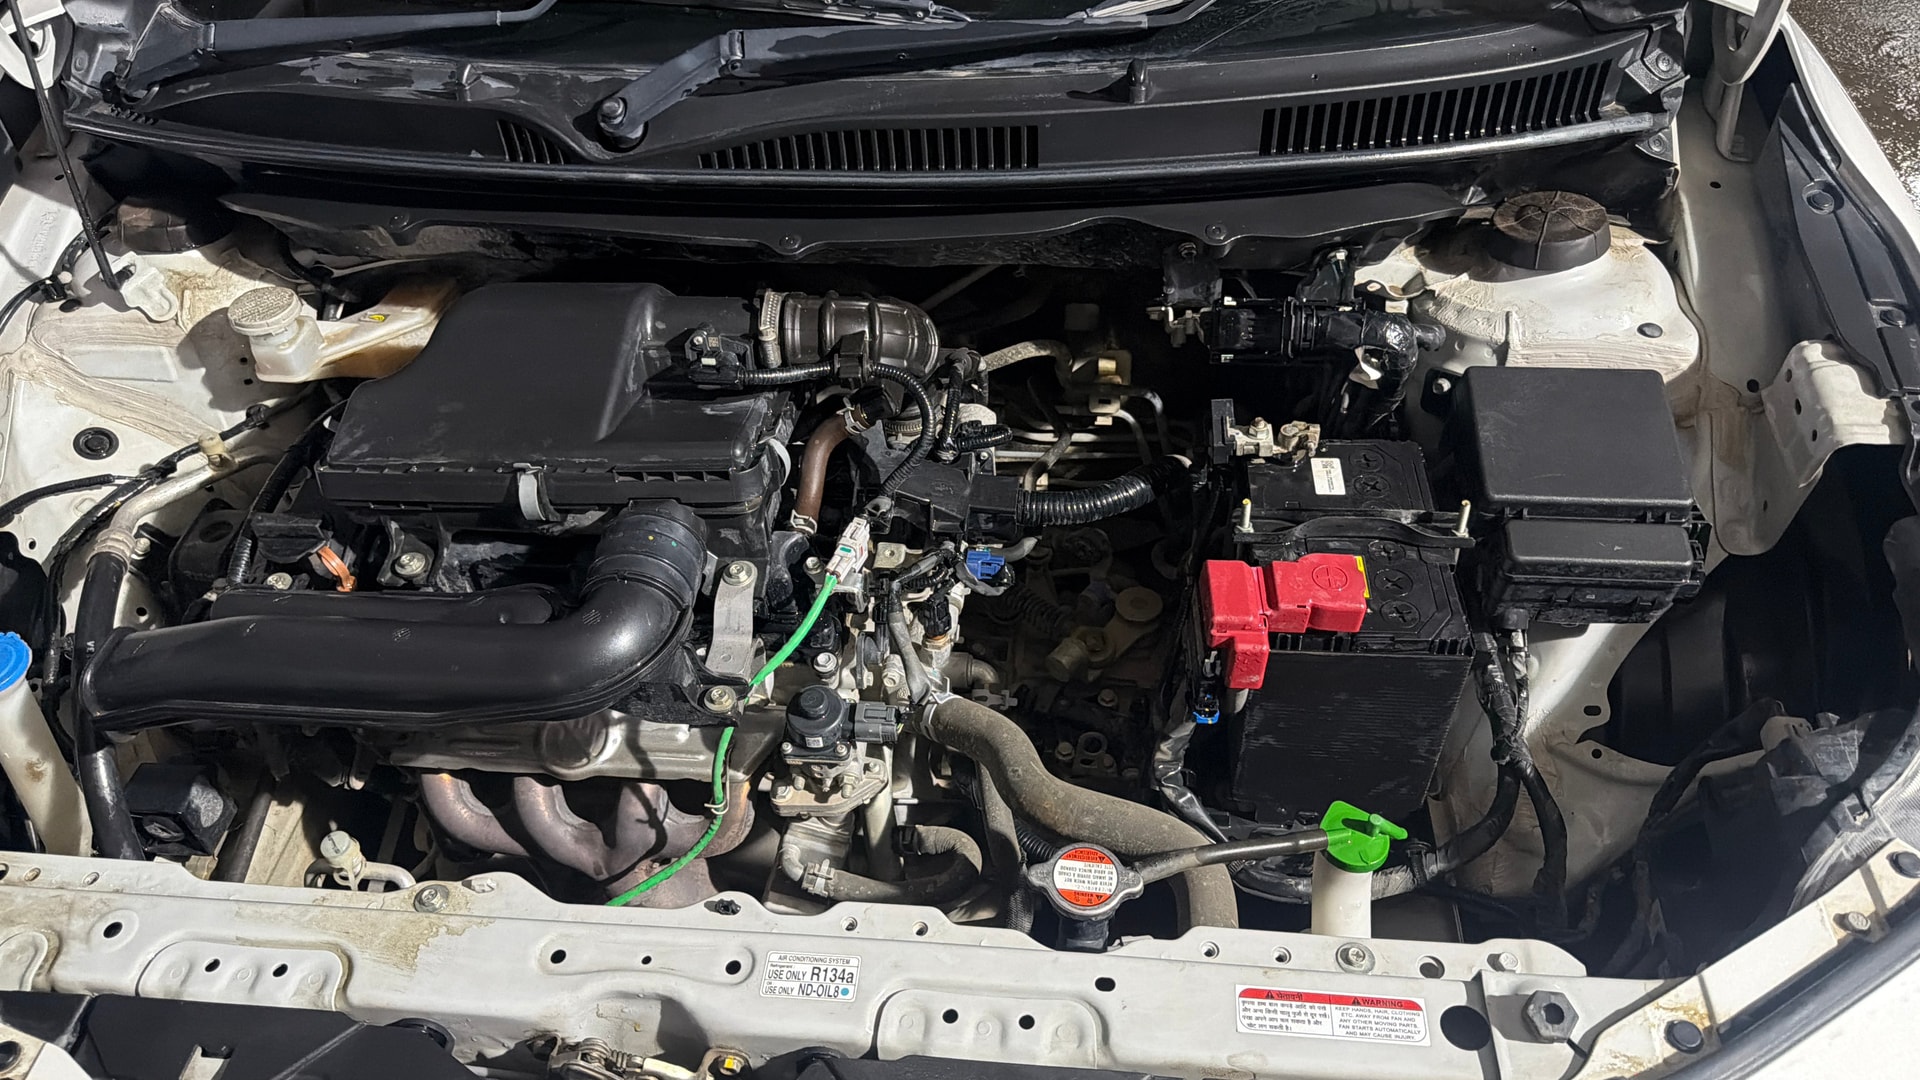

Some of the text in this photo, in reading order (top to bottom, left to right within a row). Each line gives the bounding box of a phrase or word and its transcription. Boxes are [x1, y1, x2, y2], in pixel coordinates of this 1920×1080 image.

[768, 966, 854, 983] USE ONLY R134a
[798, 984, 839, 998] ND-OIL8
[1362, 998, 1403, 1008] WARNING
